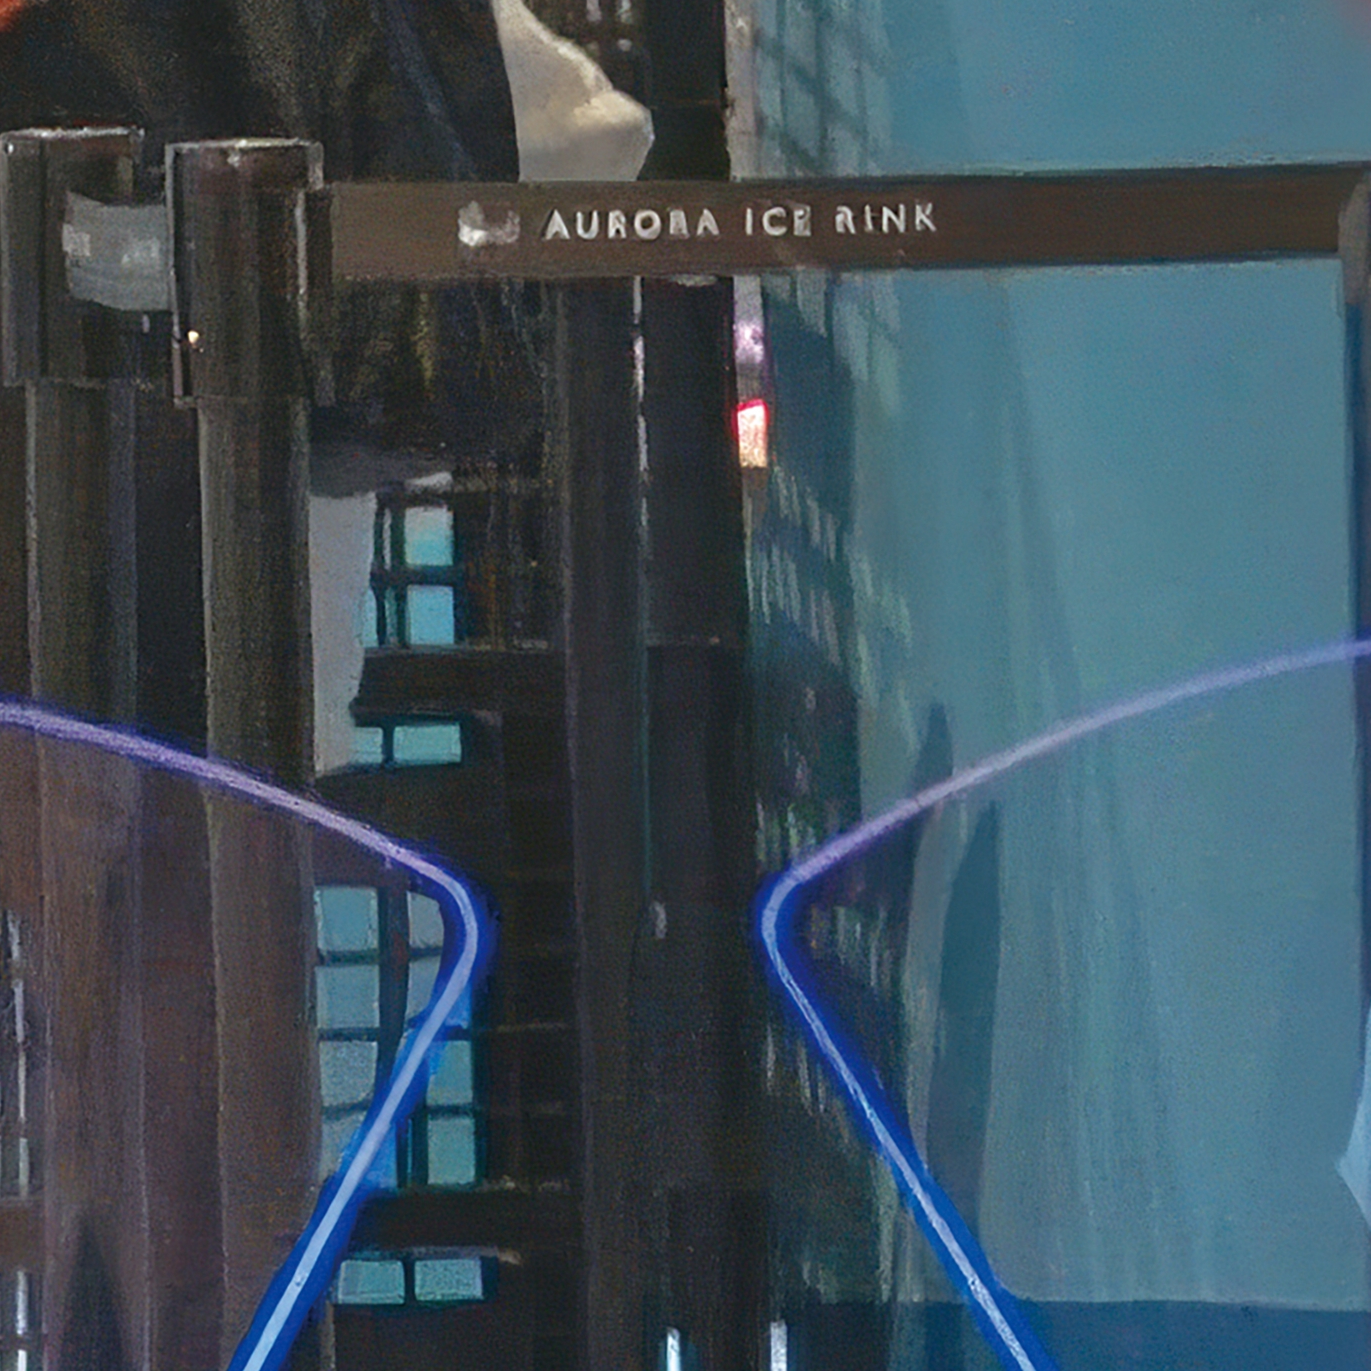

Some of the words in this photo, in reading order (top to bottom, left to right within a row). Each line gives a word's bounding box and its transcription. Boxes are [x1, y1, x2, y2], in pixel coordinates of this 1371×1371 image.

[543, 206, 721, 241] AURORA
[744, 204, 812, 237] ICE
[834, 201, 938, 235] RINK
